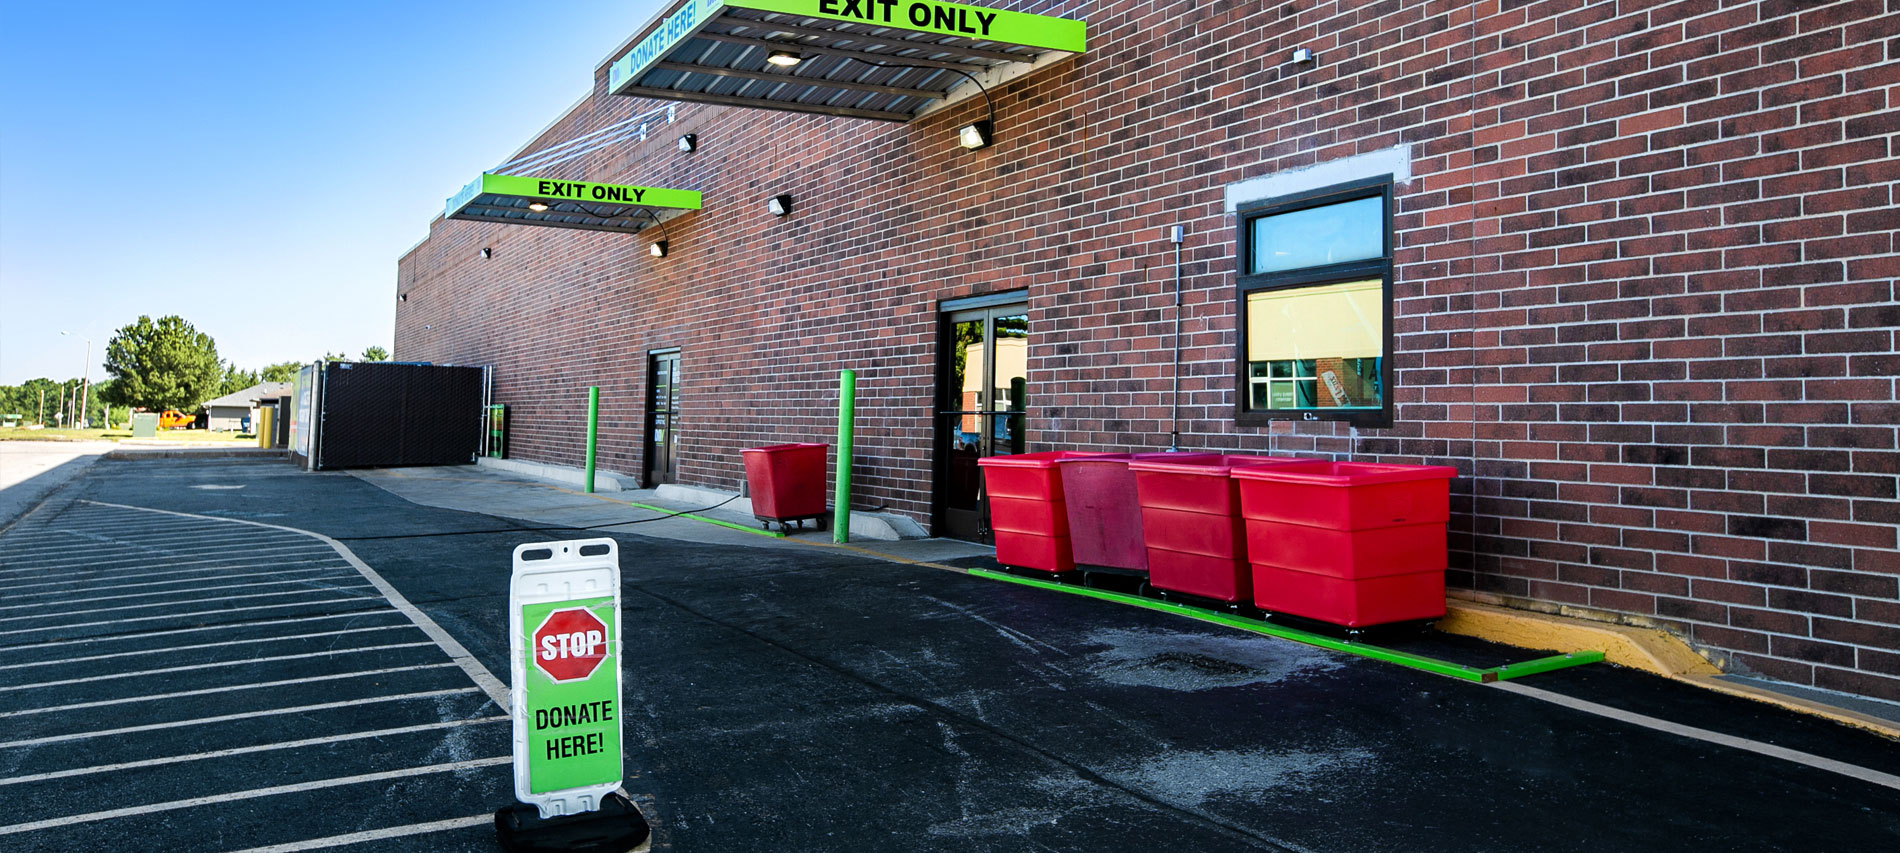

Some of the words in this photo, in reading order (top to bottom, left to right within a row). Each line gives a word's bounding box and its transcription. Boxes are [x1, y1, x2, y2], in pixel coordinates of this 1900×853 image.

[819, 0, 898, 23] EXIT
[908, 2, 997, 36] ONLY
[630, 27, 665, 75] DONATE
[667, 0, 696, 45] HERE!
[538, 181, 586, 198] EXIT
[592, 186, 646, 202] ONLY
[541, 630, 602, 661] STOP
[535, 700, 613, 730] DONATE
[546, 732, 604, 760] HERE!
